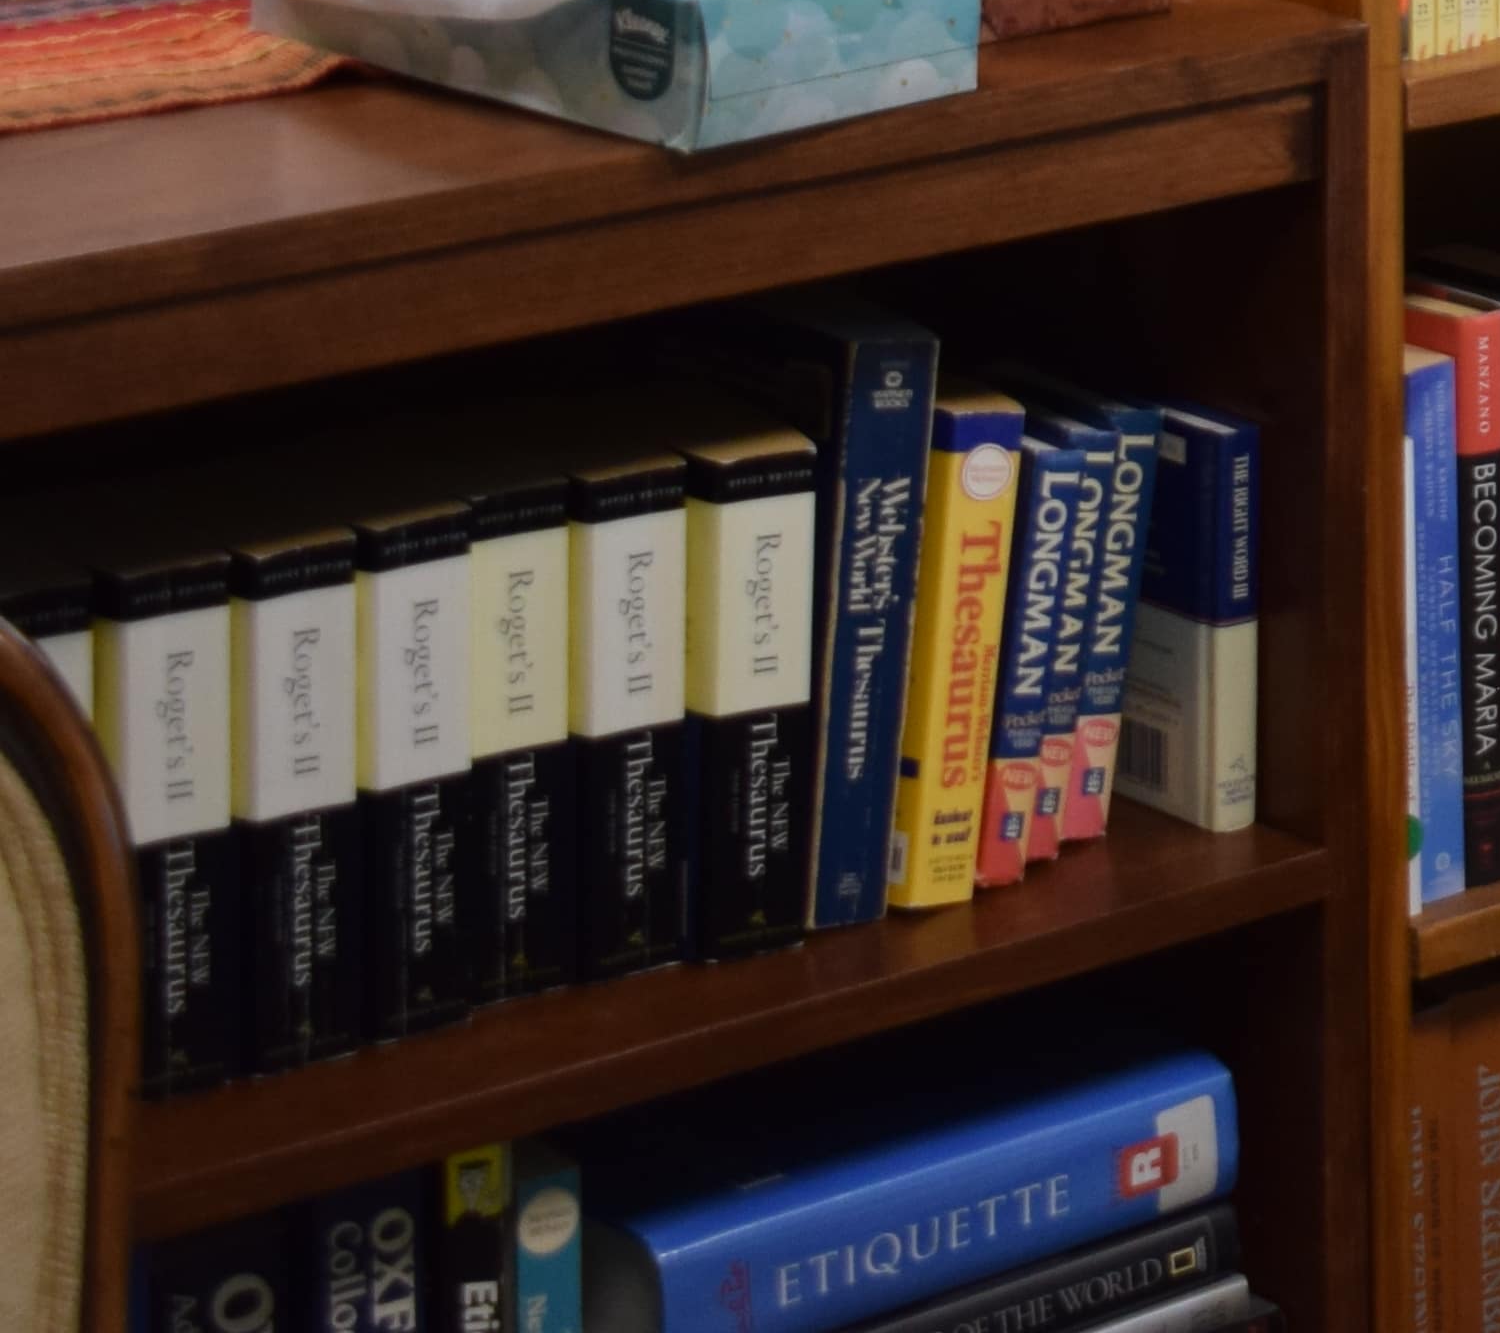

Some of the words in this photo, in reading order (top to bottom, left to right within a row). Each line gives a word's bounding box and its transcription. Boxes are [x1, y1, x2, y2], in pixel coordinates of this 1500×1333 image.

[1478, 335, 1490, 434] MANZANO
[618, 549, 655, 667] Roget's
[745, 532, 782, 646] Roget's
[879, 477, 913, 615] Webster's
[1013, 470, 1079, 696] LONGMAN
[1092, 434, 1155, 654] LONGMAN
[1473, 462, 1497, 642] BECOMING
[846, 618, 886, 781] Thesaurus
[940, 519, 1002, 791] Thesaurus
[624, 732, 652, 897] Thesaurus
[747, 714, 777, 879] Thesaurus
[770, 799, 791, 851] NEW
[771, 756, 792, 793] The
[774, 1173, 1072, 1309] ETIQUETTE
